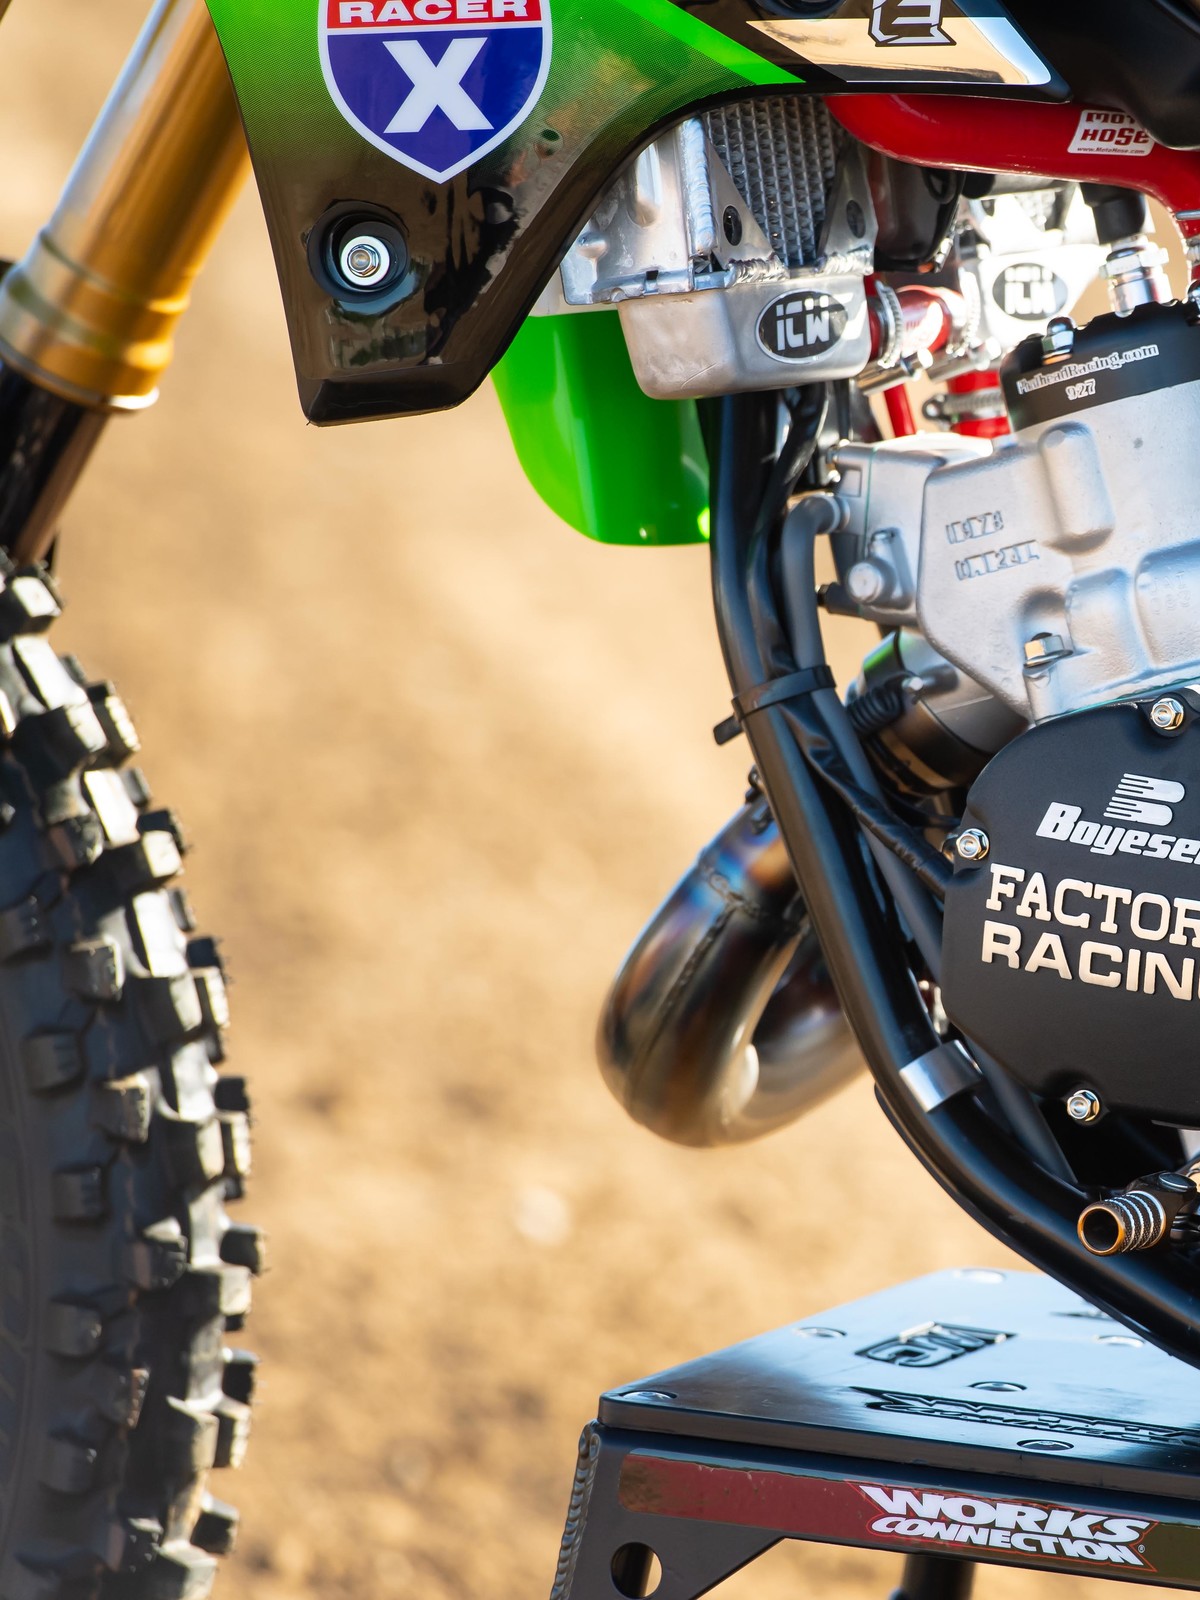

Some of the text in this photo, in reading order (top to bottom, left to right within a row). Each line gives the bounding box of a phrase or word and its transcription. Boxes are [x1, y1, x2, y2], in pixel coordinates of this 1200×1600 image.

[338, 0, 529, 24] RACER
[382, 37, 495, 134] X
[1065, 378, 1097, 401] 927
[859, 1485, 1150, 1543] WORKS
[871, 1516, 1144, 1566] CONNECTION
